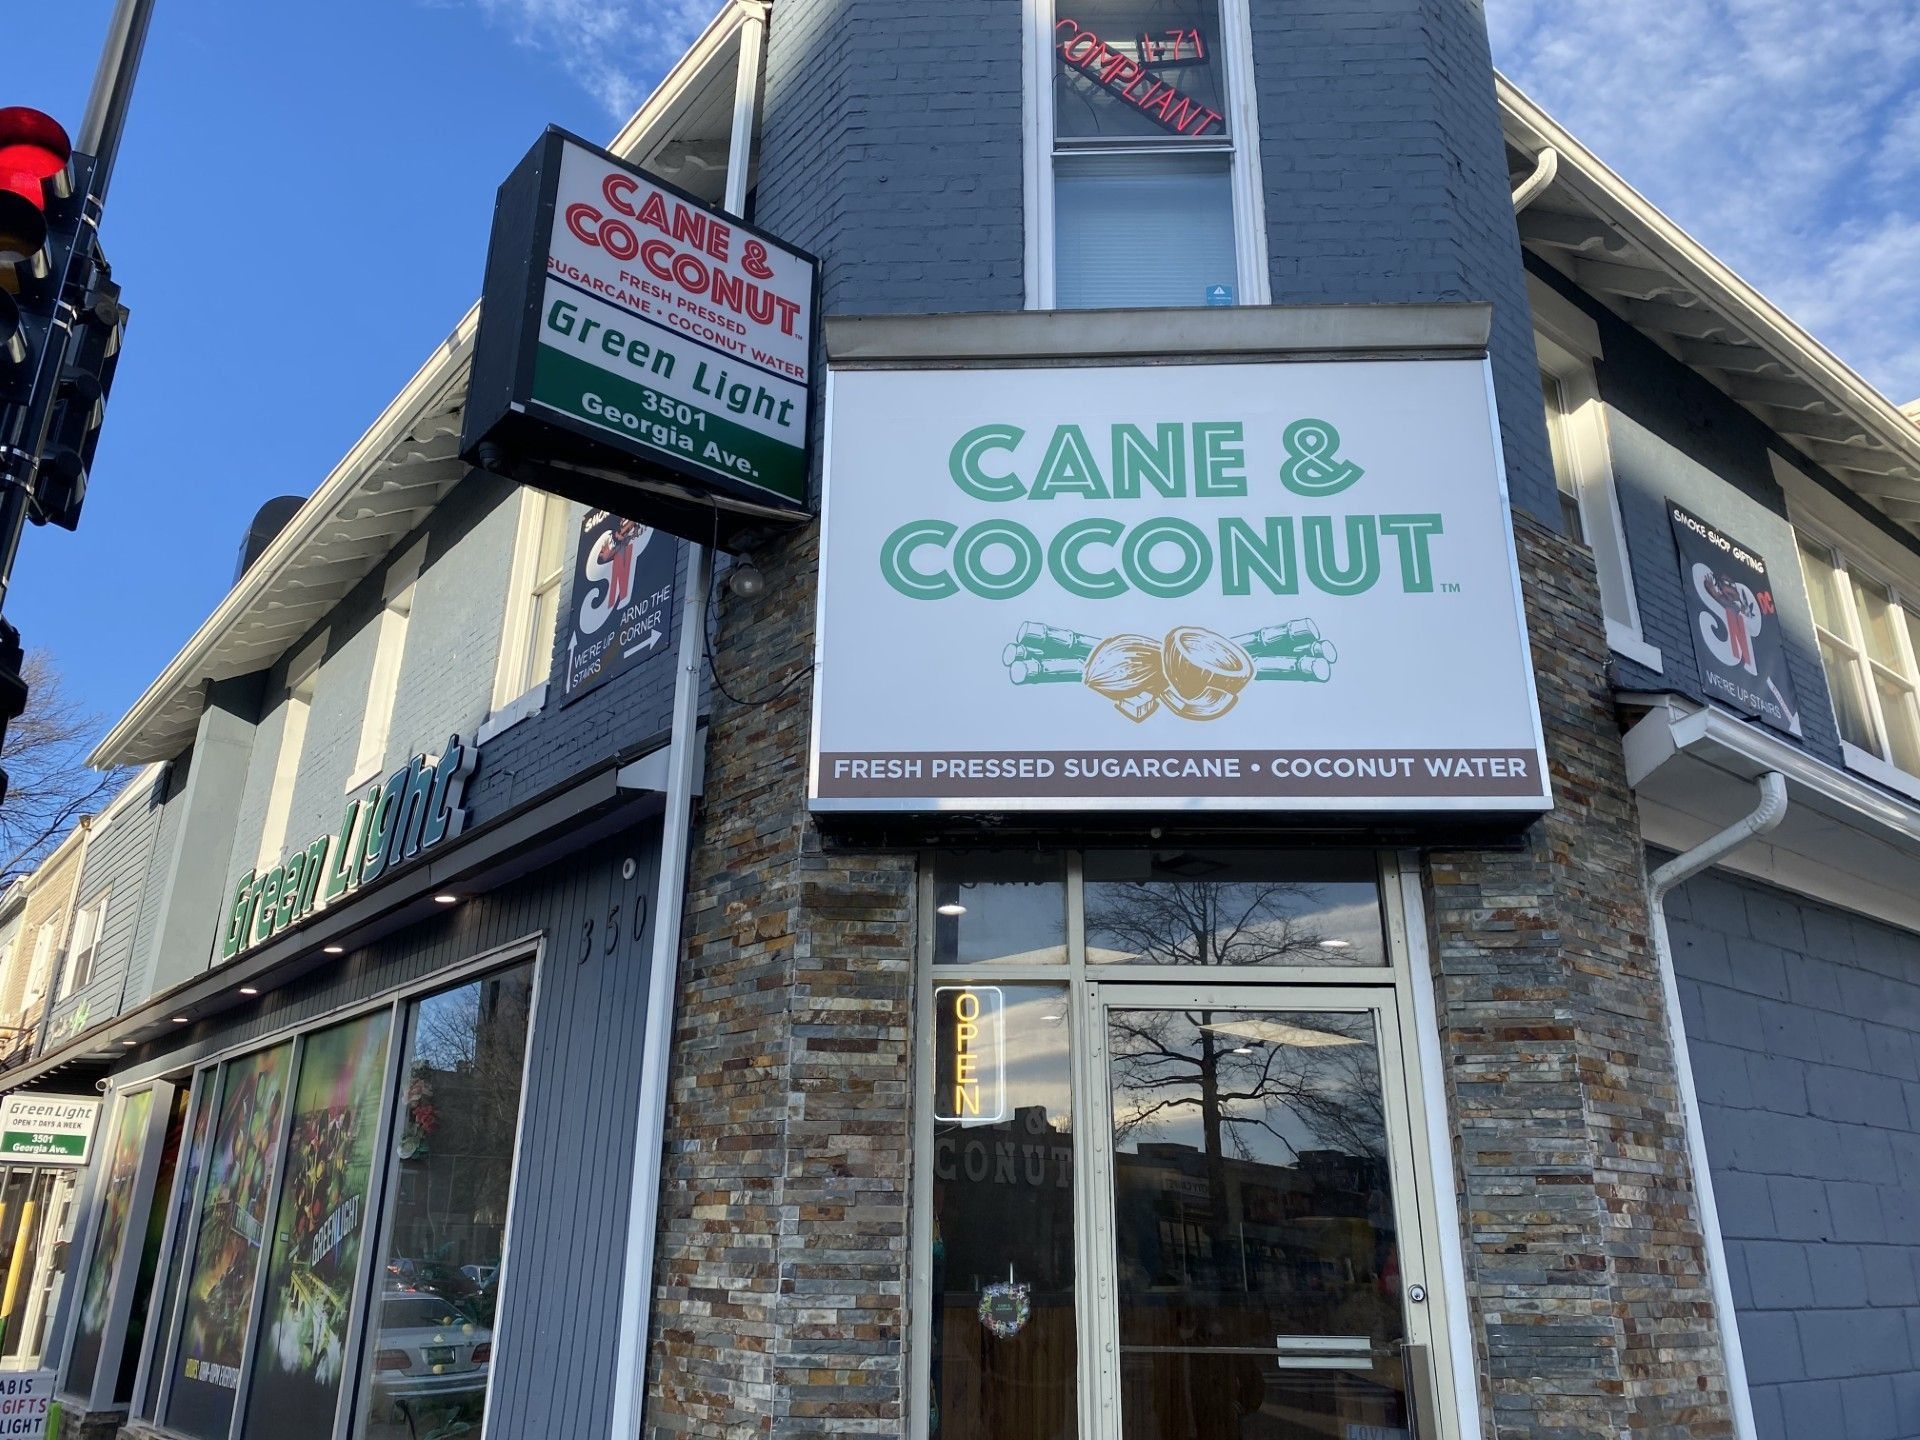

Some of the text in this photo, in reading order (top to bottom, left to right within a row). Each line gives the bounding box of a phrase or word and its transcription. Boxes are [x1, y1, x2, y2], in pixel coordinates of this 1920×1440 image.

[1056, 19, 1222, 135] COMPLIANT
[602, 173, 775, 280] CANE &
[565, 203, 801, 336] COCONUT
[547, 255, 805, 379] SUGARCANE COCONUT WATER
[619, 271, 747, 336] FRESH PRESSED
[547, 299, 795, 427] Green Light
[642, 389, 707, 432] 3501
[582, 392, 760, 478] Georgia Ave.
[948, 417, 1365, 502] CANE &
[1673, 509, 1707, 538] SMOKE
[1707, 530, 1731, 553] SHOP
[880, 513, 1444, 600] COCONUT
[620, 584, 671, 627] ARND THE
[602, 631, 615, 651] UP
[619, 610, 662, 646] CORNER
[572, 658, 601, 688] STAIRS
[1737, 683, 1749, 703] UP
[1749, 692, 1782, 719] STAIRS
[834, 757, 1528, 779] FRESH PRESSED SUGARCANE COCONUT WATER
[222, 734, 470, 961] Green Light
[954, 993, 980, 1116] OPEN
[12, 1118, 31, 1126] OPEN
[39, 1120, 55, 1128] DAYS
[63, 1121, 82, 1129] WEEK
[31, 1134, 54, 1144] 3501
[12, 1143, 68, 1154] Georgia Ave.
[3, 1398, 47, 1415] GIFTS
